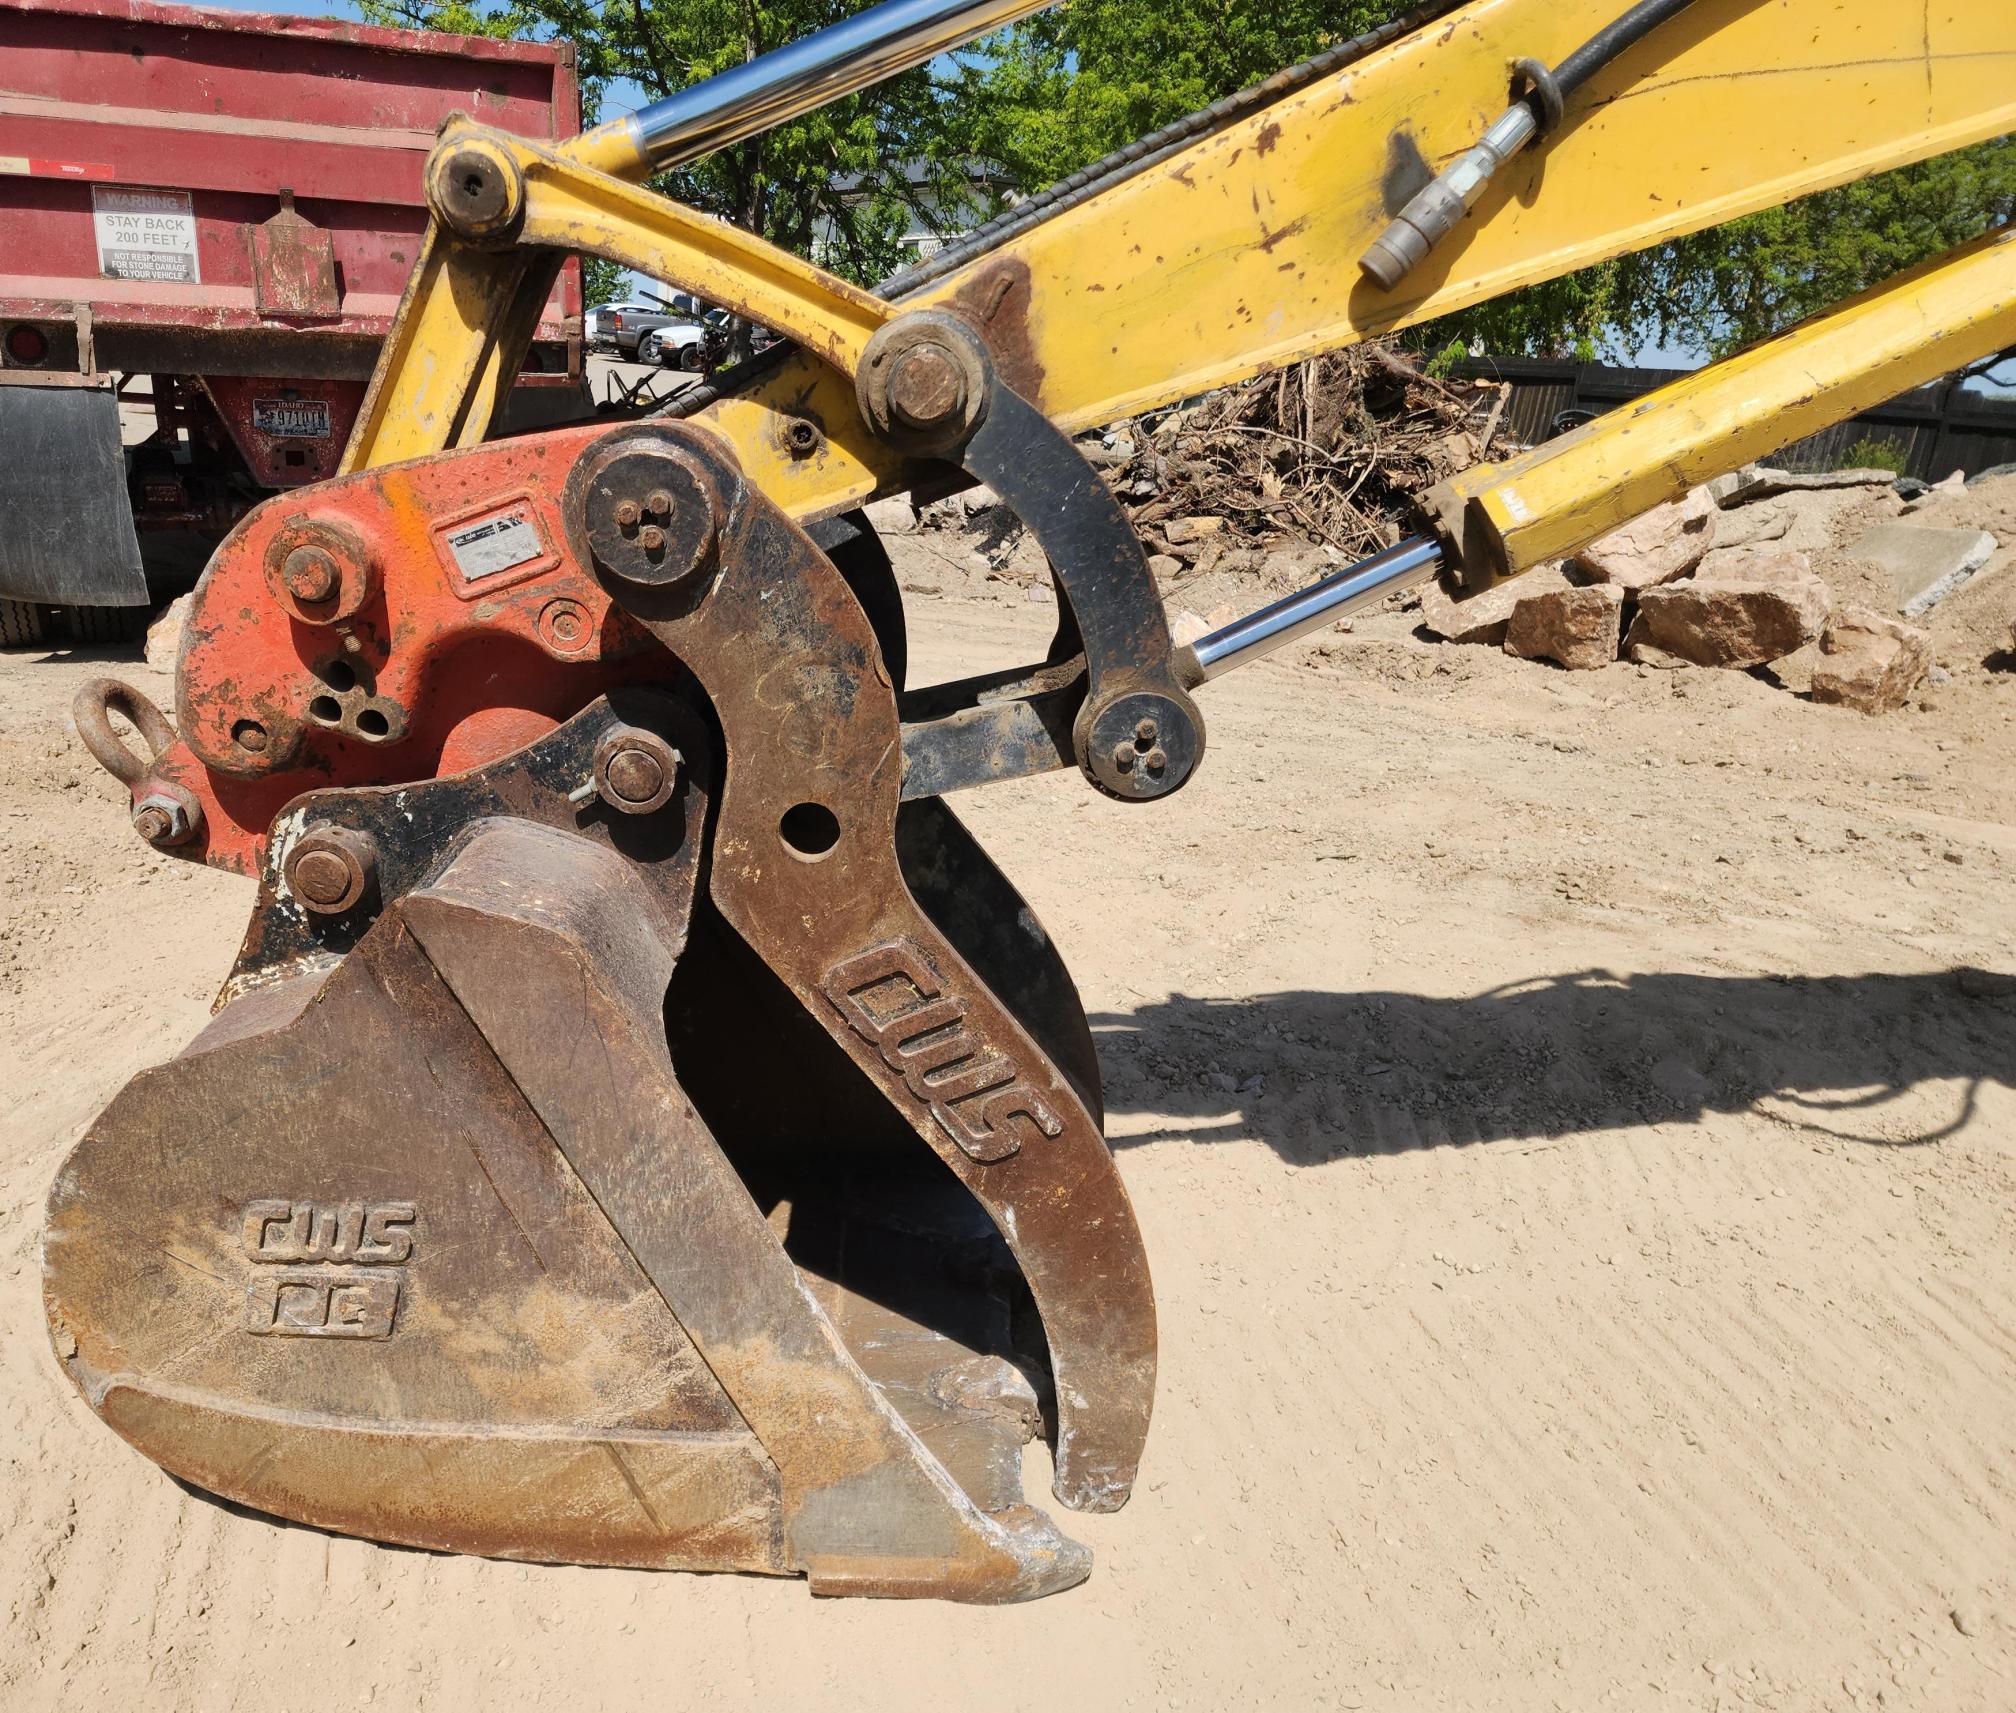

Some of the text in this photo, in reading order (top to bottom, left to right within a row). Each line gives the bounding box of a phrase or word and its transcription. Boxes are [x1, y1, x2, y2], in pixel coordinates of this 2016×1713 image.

[105, 192, 179, 209] WARNING
[105, 215, 185, 231] STAY BACK
[115, 231, 178, 245] 200 FEET
[114, 252, 183, 264] NOT RESPONSIBLE
[111, 260, 187, 272] FOR STONE DAMAGE
[118, 269, 183, 280] TO YOUR VEHICLE
[822, 933, 1065, 1165] CWS
[242, 1199, 417, 1265] CWS
